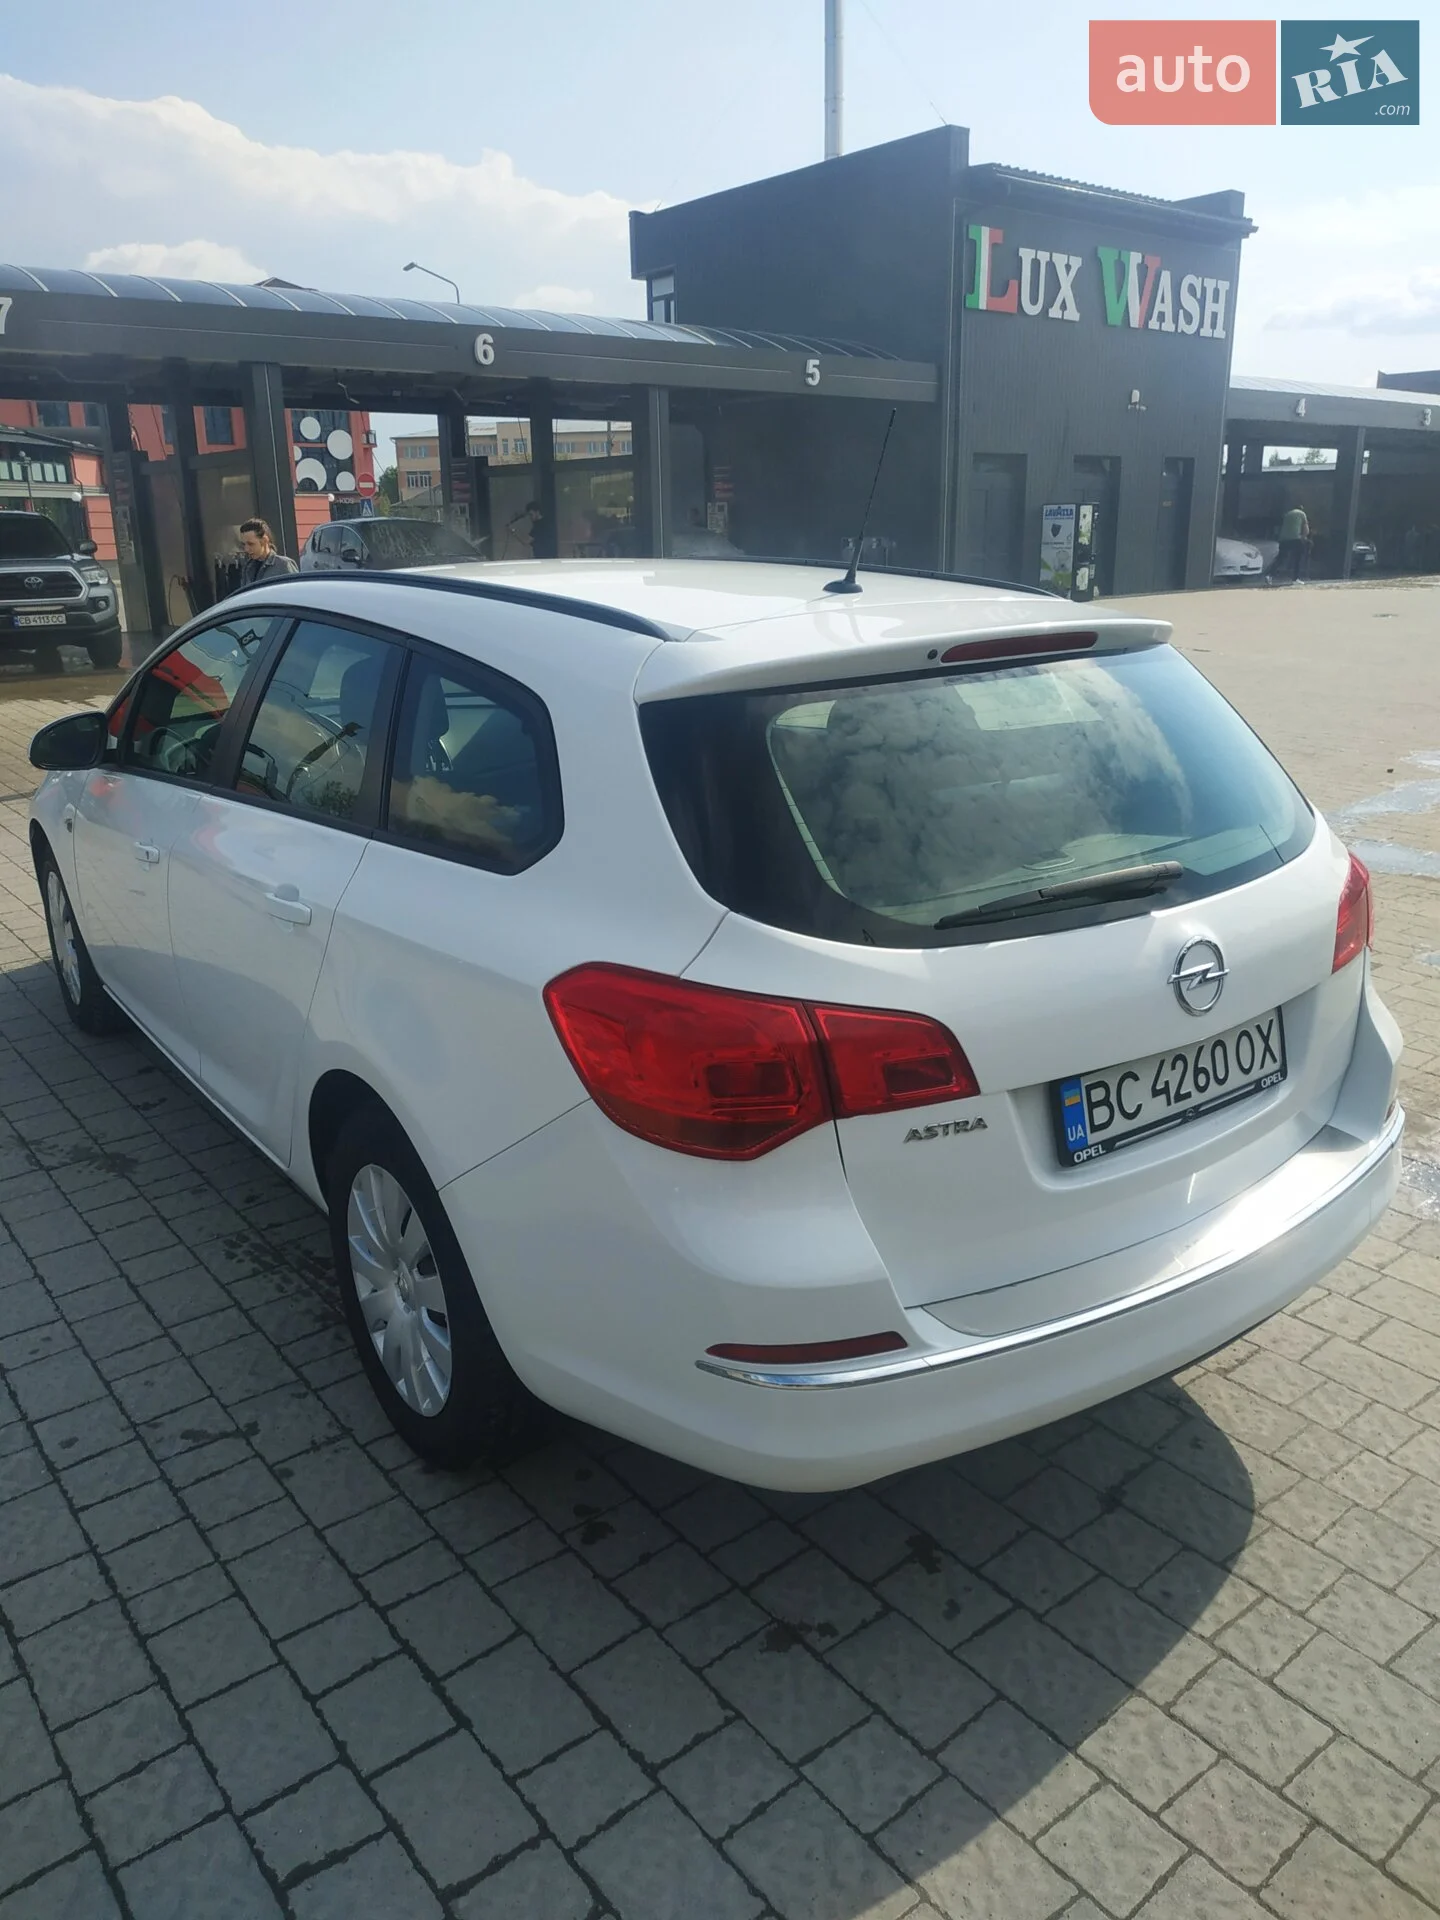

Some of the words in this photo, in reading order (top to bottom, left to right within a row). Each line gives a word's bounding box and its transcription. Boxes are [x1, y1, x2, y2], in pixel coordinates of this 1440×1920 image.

[965, 224, 1083, 322] LUX
[1097, 246, 1230, 339] WASH
[0, 296, 13, 334] 7
[476, 333, 495, 365] 6
[805, 359, 821, 386] 5
[1296, 398, 1307, 417] 4
[1421, 408, 1432, 426] 3
[1085, 1070, 1143, 1134] BC
[1151, 1039, 1230, 1107] 4260
[1235, 1019, 1278, 1076] OX
[1261, 1071, 1284, 1089] OPEL
[903, 1115, 988, 1144] ASTRA
[1067, 1124, 1086, 1142] UA
[1073, 1144, 1107, 1164] OPEL
